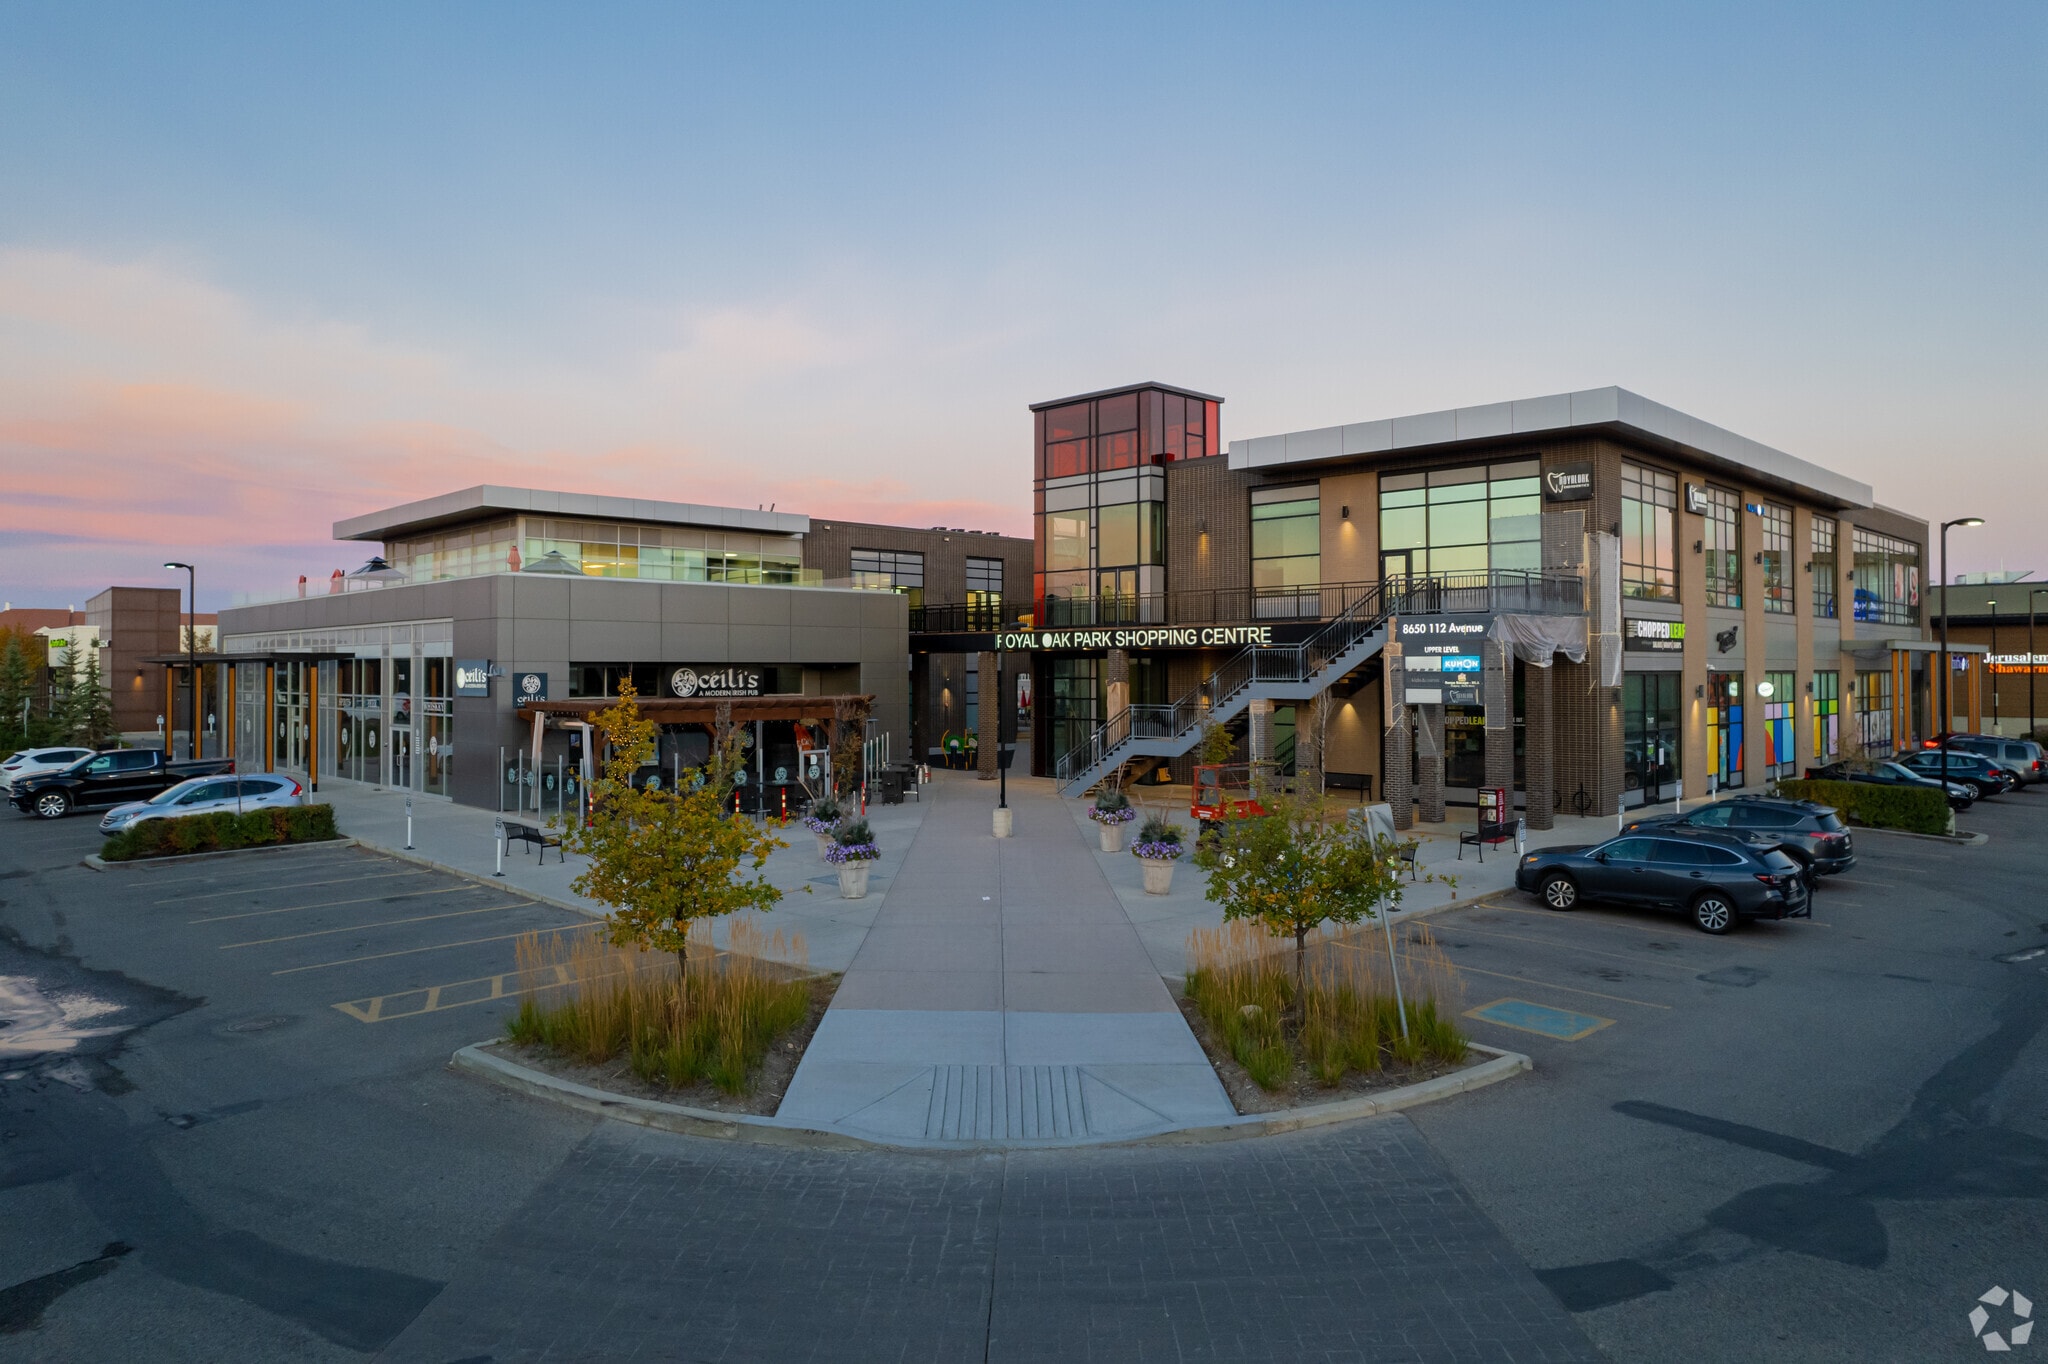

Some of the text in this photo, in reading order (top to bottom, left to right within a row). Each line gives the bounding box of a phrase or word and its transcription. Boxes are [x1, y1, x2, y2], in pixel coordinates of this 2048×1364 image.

[1403, 622, 1483, 634] 8650 112 Avenue
[1638, 620, 1670, 638] CHOPPED
[1042, 632, 1070, 648] OAK
[1074, 631, 1112, 648] PARK
[1115, 629, 1197, 647] SHOPPING
[1201, 627, 1272, 644] CENTRE
[1445, 659, 1478, 668] KUMON
[1983, 652, 2048, 664] Jerusalem
[1989, 663, 2048, 673] Shawarm
[1445, 716, 1468, 725] OPPED
